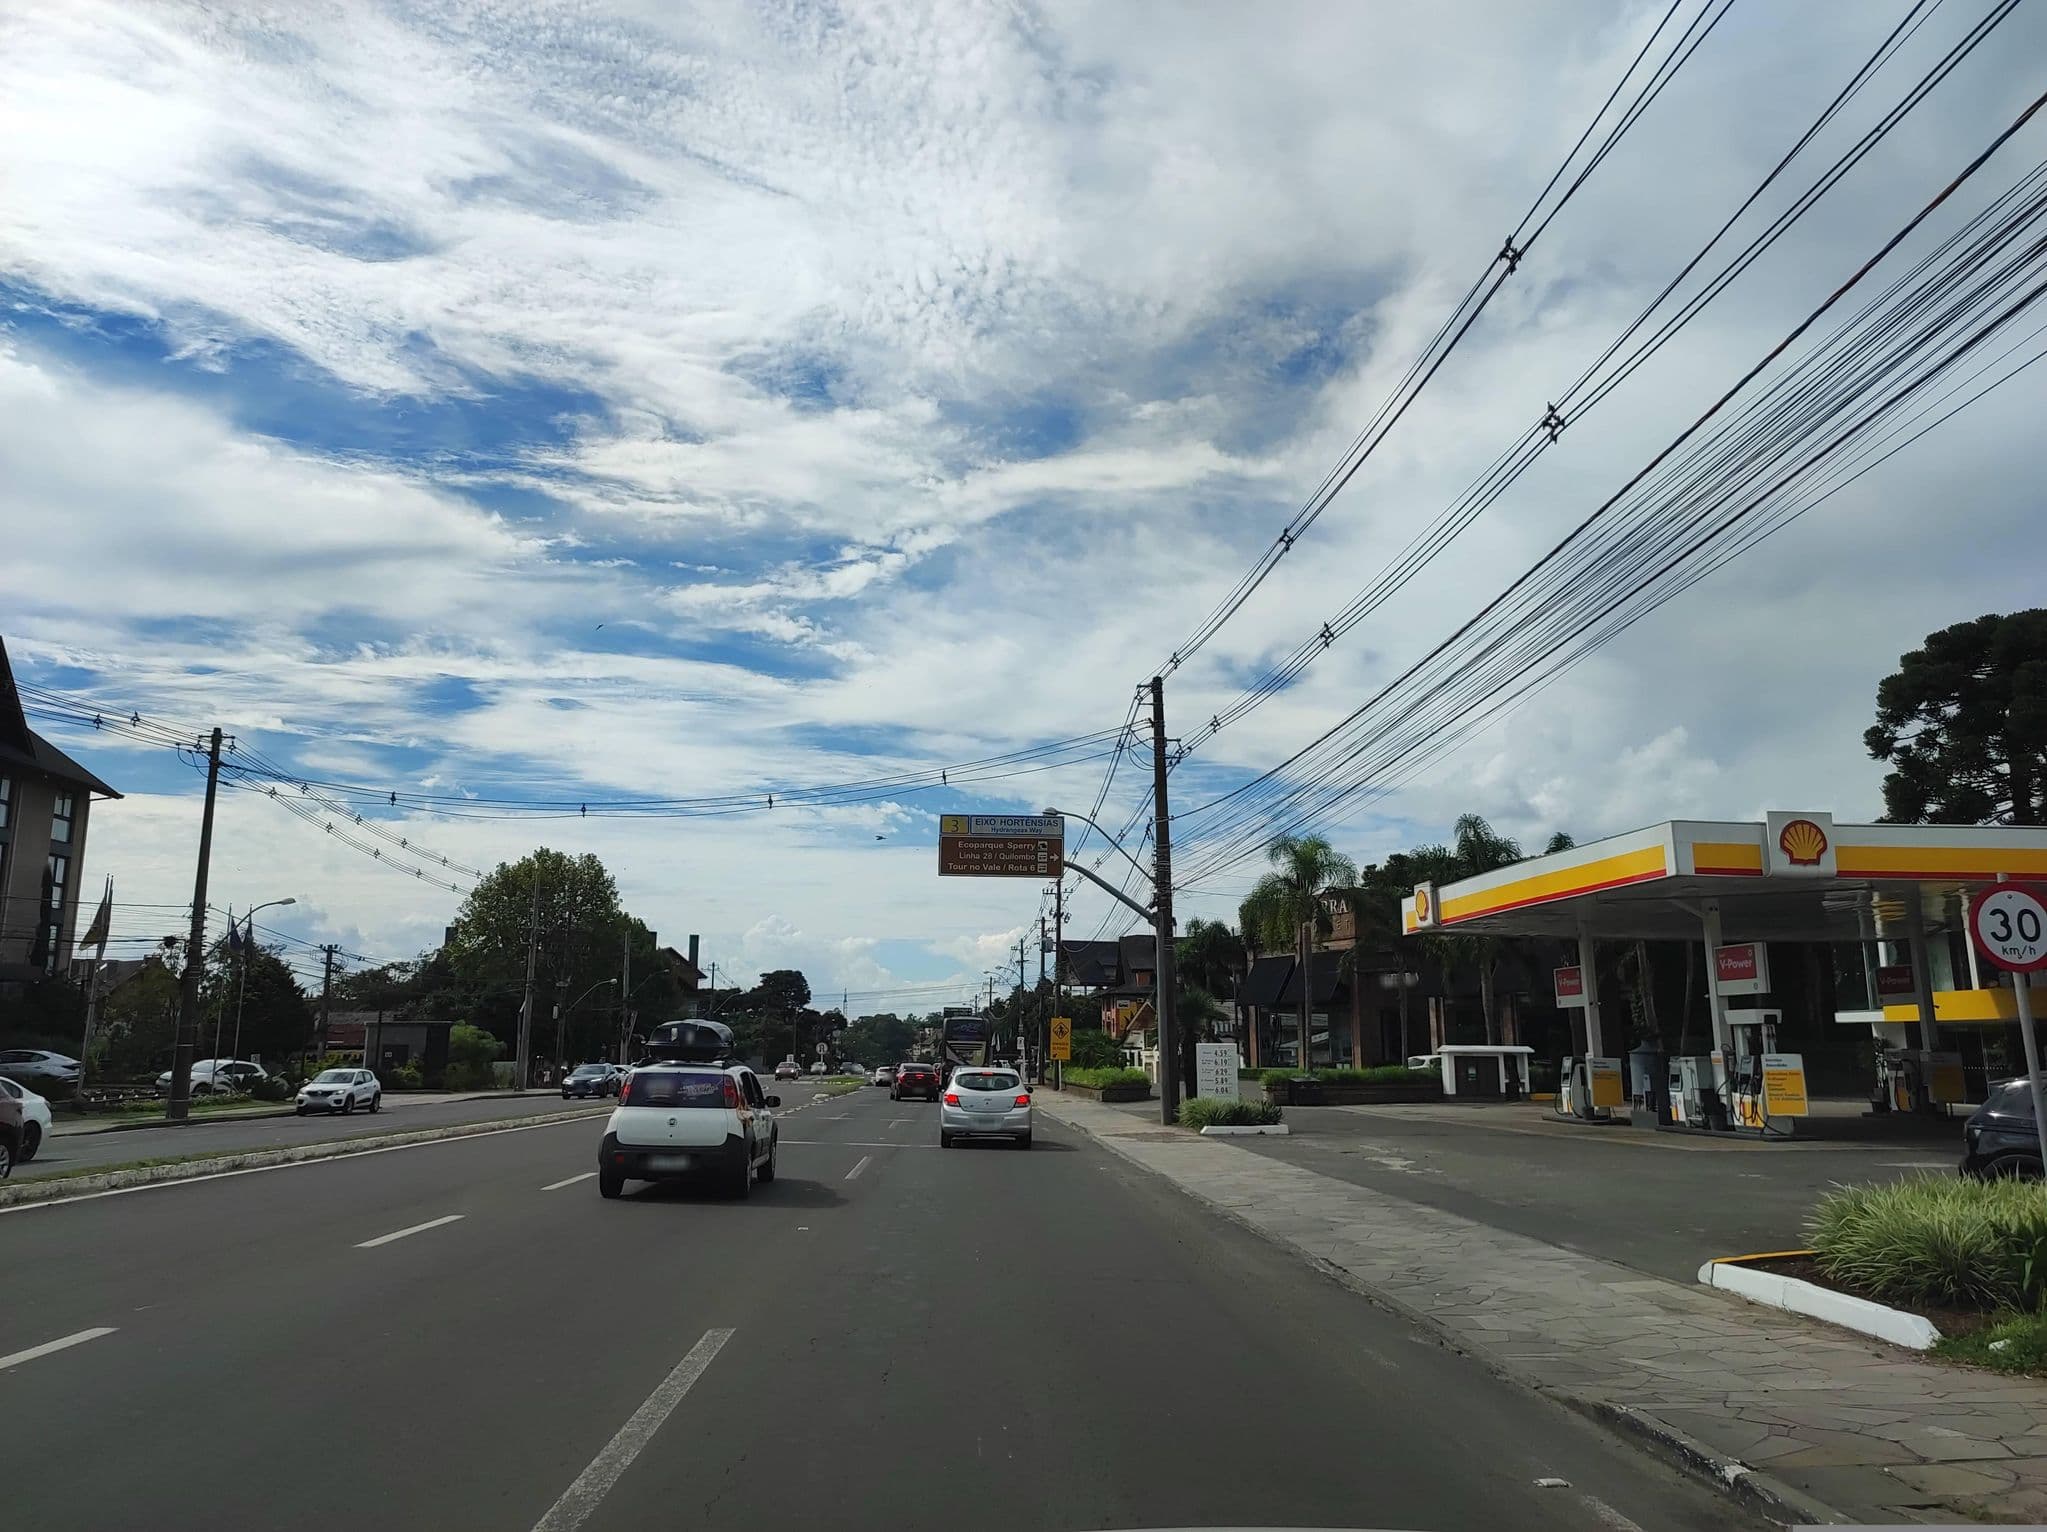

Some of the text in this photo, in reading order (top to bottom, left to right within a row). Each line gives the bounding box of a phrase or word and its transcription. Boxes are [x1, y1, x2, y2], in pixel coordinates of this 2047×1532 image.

[951, 819, 960, 833] 3
[975, 818, 996, 826] EIXO
[958, 841, 1036, 851] Ecoparque Sperry
[959, 852, 980, 860] Linha
[999, 852, 1036, 861] Quilombo
[948, 862, 967, 871] Tour
[983, 863, 1001, 871] Vale
[1008, 863, 1028, 872] Rota
[1030, 864, 1036, 872] 6
[1989, 908, 2041, 942] 30
[2002, 945, 2036, 956] km/h
[1719, 958, 1753, 970] V-Power
